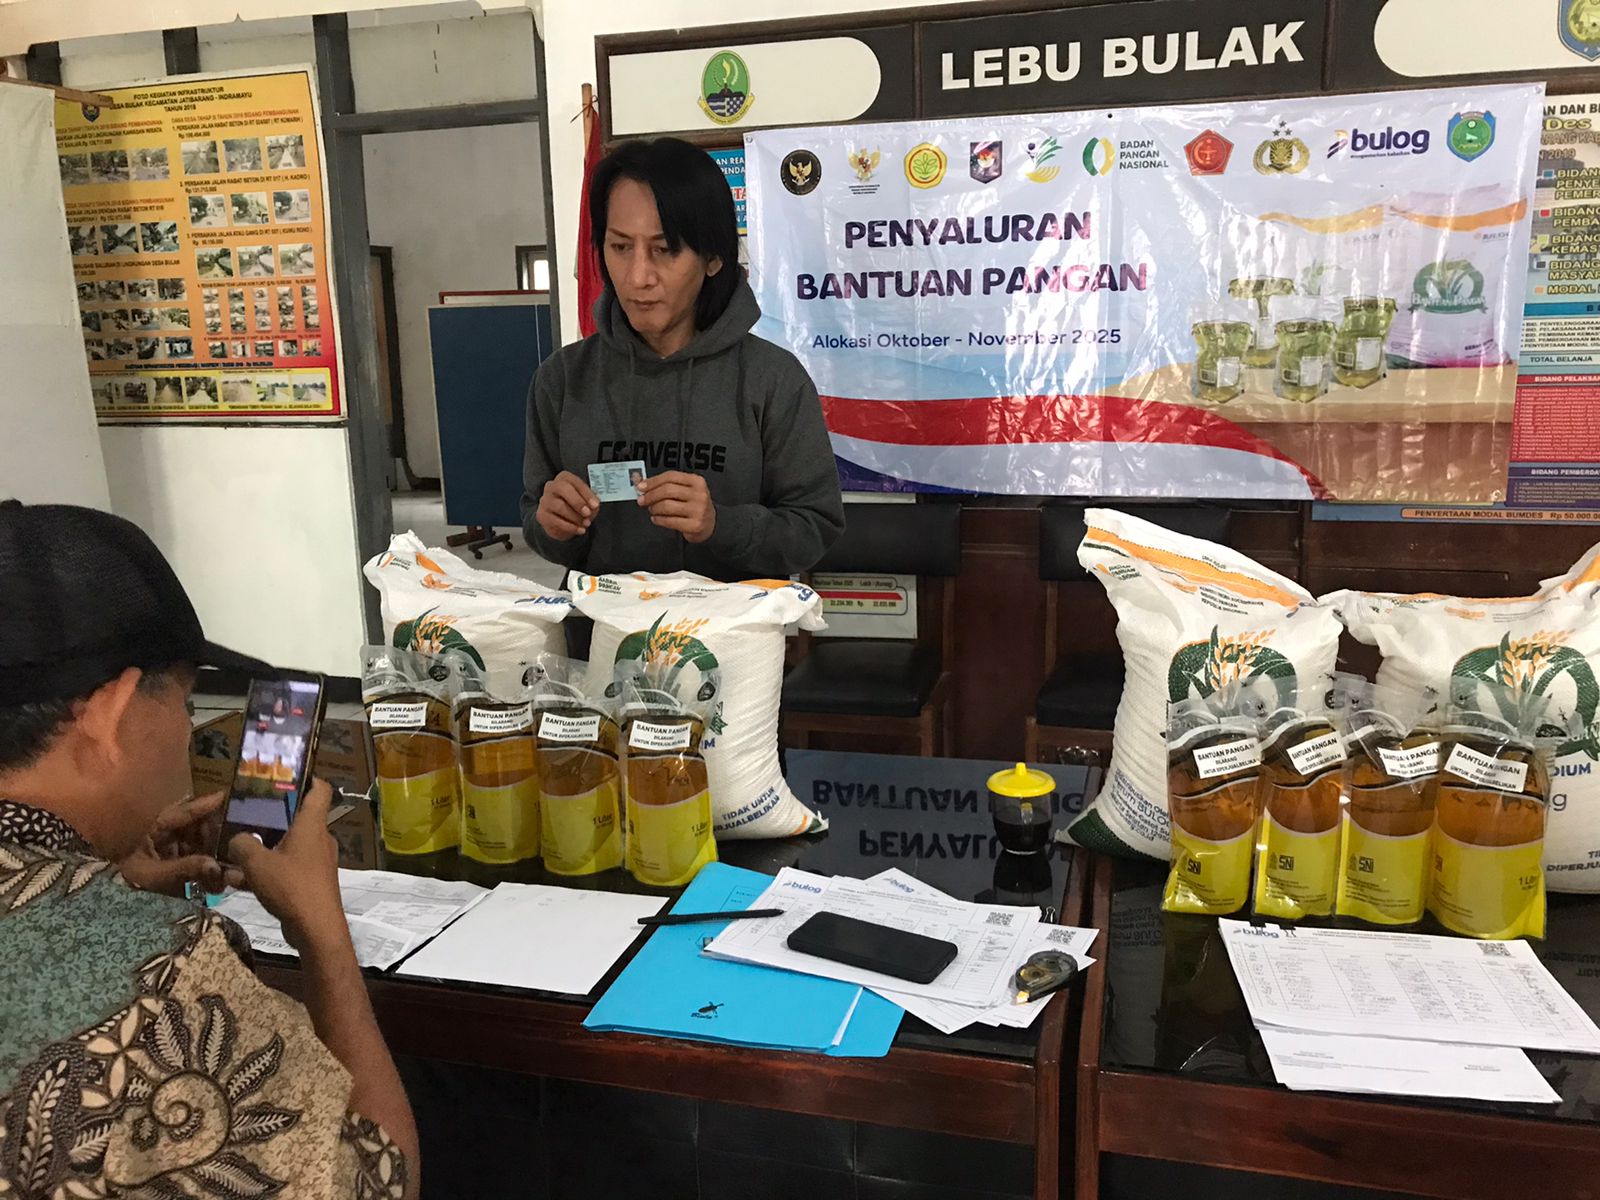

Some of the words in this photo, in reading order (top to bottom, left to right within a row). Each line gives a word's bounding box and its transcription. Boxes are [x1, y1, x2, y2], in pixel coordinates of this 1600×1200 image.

[941, 41, 1082, 91] LEBU
[1102, 20, 1305, 78] BULAK
[177, 86, 224, 96] INFRASTRUKTUR
[145, 98, 178, 107] KECAMATAN
[218, 92, 252, 101] INDRAMAYU
[164, 103, 183, 112] TAHUN
[1560, 104, 1586, 115] DAN
[1120, 139, 1154, 149] BADAN
[1351, 126, 1430, 154] bulog
[1120, 150, 1160, 160] PANGAN
[1119, 160, 1169, 170] NASIONAL
[1557, 168, 1600, 178] BIDAN
[845, 211, 1092, 248] PENYALURAN
[1550, 260, 1600, 270] BIDANG
[796, 267, 971, 300] BANTUAN
[982, 263, 1148, 295] PANGAN
[1547, 285, 1596, 295] MODAL
[813, 333, 872, 349] Alokasi
[878, 332, 950, 348] Oktober
[968, 329, 1067, 347] November
[1071, 328, 1122, 344] 2025
[1414, 510, 1471, 518] PENYERTAAN
[1473, 510, 1503, 518] MODAL
[1505, 510, 1544, 519] BUMDES
[1550, 511, 1563, 520] Rp
[403, 705, 424, 713] PANGAN
[473, 711, 504, 719] BANTUAN
[504, 708, 529, 718] PANGAN
[545, 716, 576, 726] BANTUAN
[636, 723, 667, 734] BANTUAN
[668, 726, 689, 734] PANGAN
[1311, 737, 1338, 752] PANGAN
[1198, 749, 1225, 761] BANTUAN
[1225, 743, 1256, 756] PANGAN
[1456, 750, 1494, 770] BANTUAN
[722, 805, 751, 821] TIDAK
[751, 786, 775, 809] UNTUK
[1136, 800, 1170, 827] BULO
[1279, 856, 1295, 871] SNI
[1359, 857, 1374, 873] SNI
[791, 881, 822, 894] bulog
